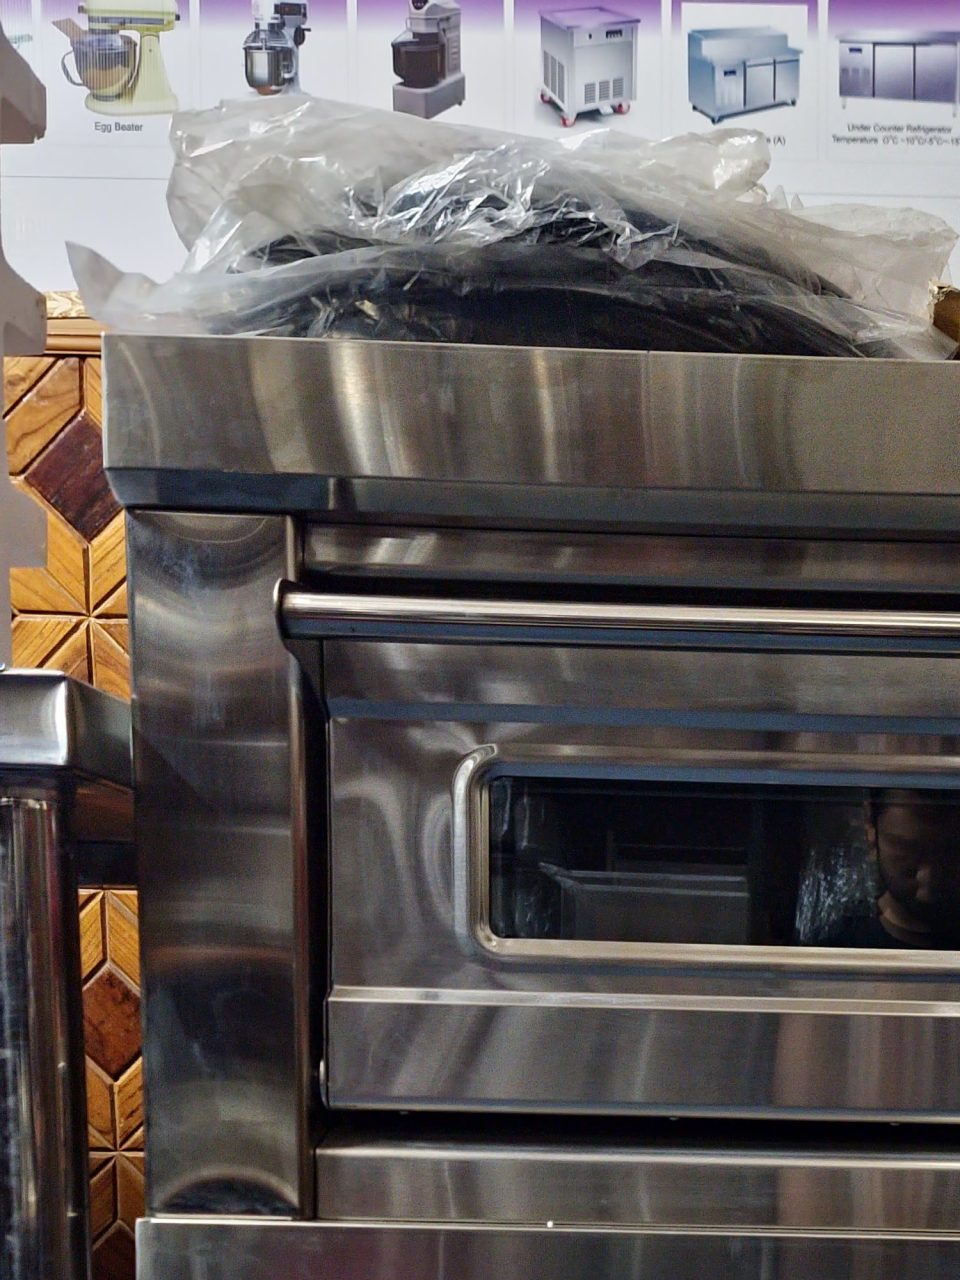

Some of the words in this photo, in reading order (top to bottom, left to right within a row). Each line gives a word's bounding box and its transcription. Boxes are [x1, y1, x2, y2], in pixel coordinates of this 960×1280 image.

[94, 121, 112, 133] Egg
[114, 121, 143, 132] Beater
[847, 124, 871, 132] Under
[873, 124, 904, 133] Counter
[906, 125, 952, 135] Refrigerator
[831, 134, 879, 145] Temperature
